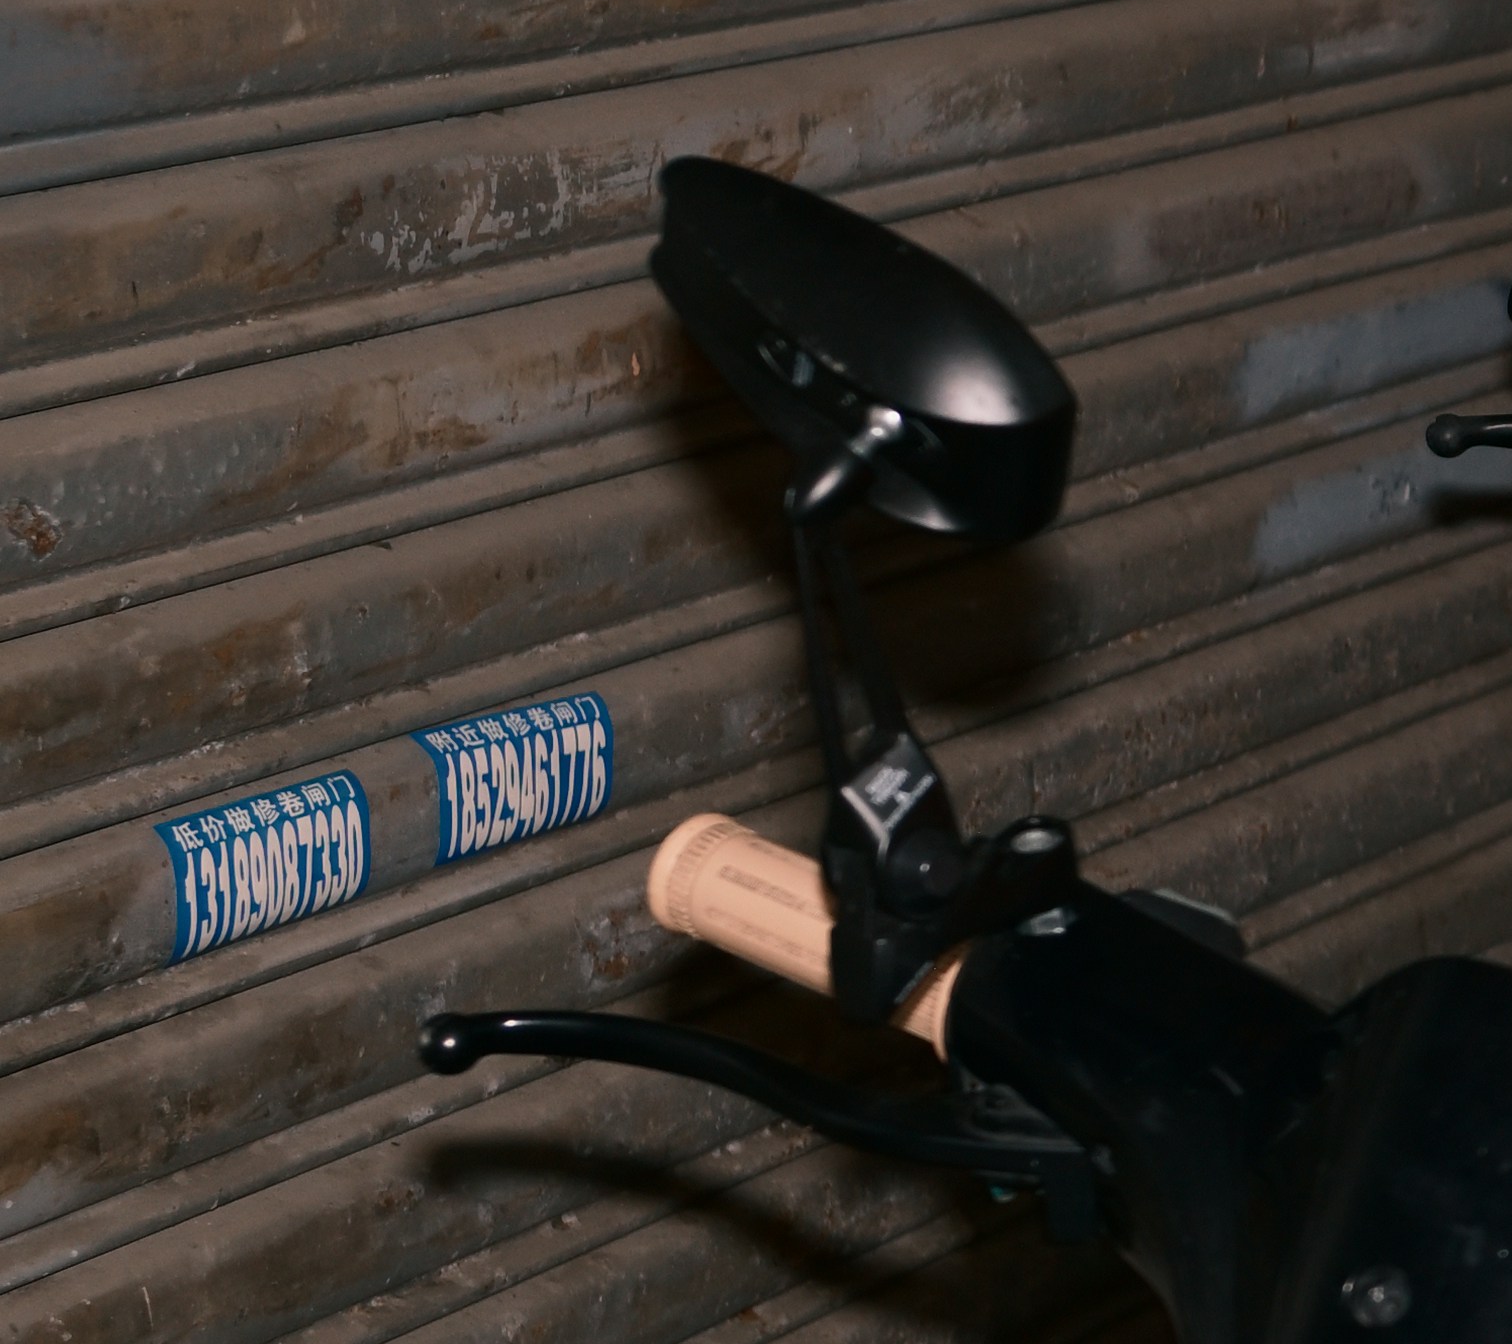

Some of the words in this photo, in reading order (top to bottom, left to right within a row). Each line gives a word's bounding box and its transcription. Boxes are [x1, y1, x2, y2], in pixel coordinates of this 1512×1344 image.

[425, 696, 600, 753] 附近做修卷闸门
[172, 775, 355, 852] 低价做修卷闸门
[446, 719, 606, 859] 18529461776
[181, 799, 364, 959] 13189087330
